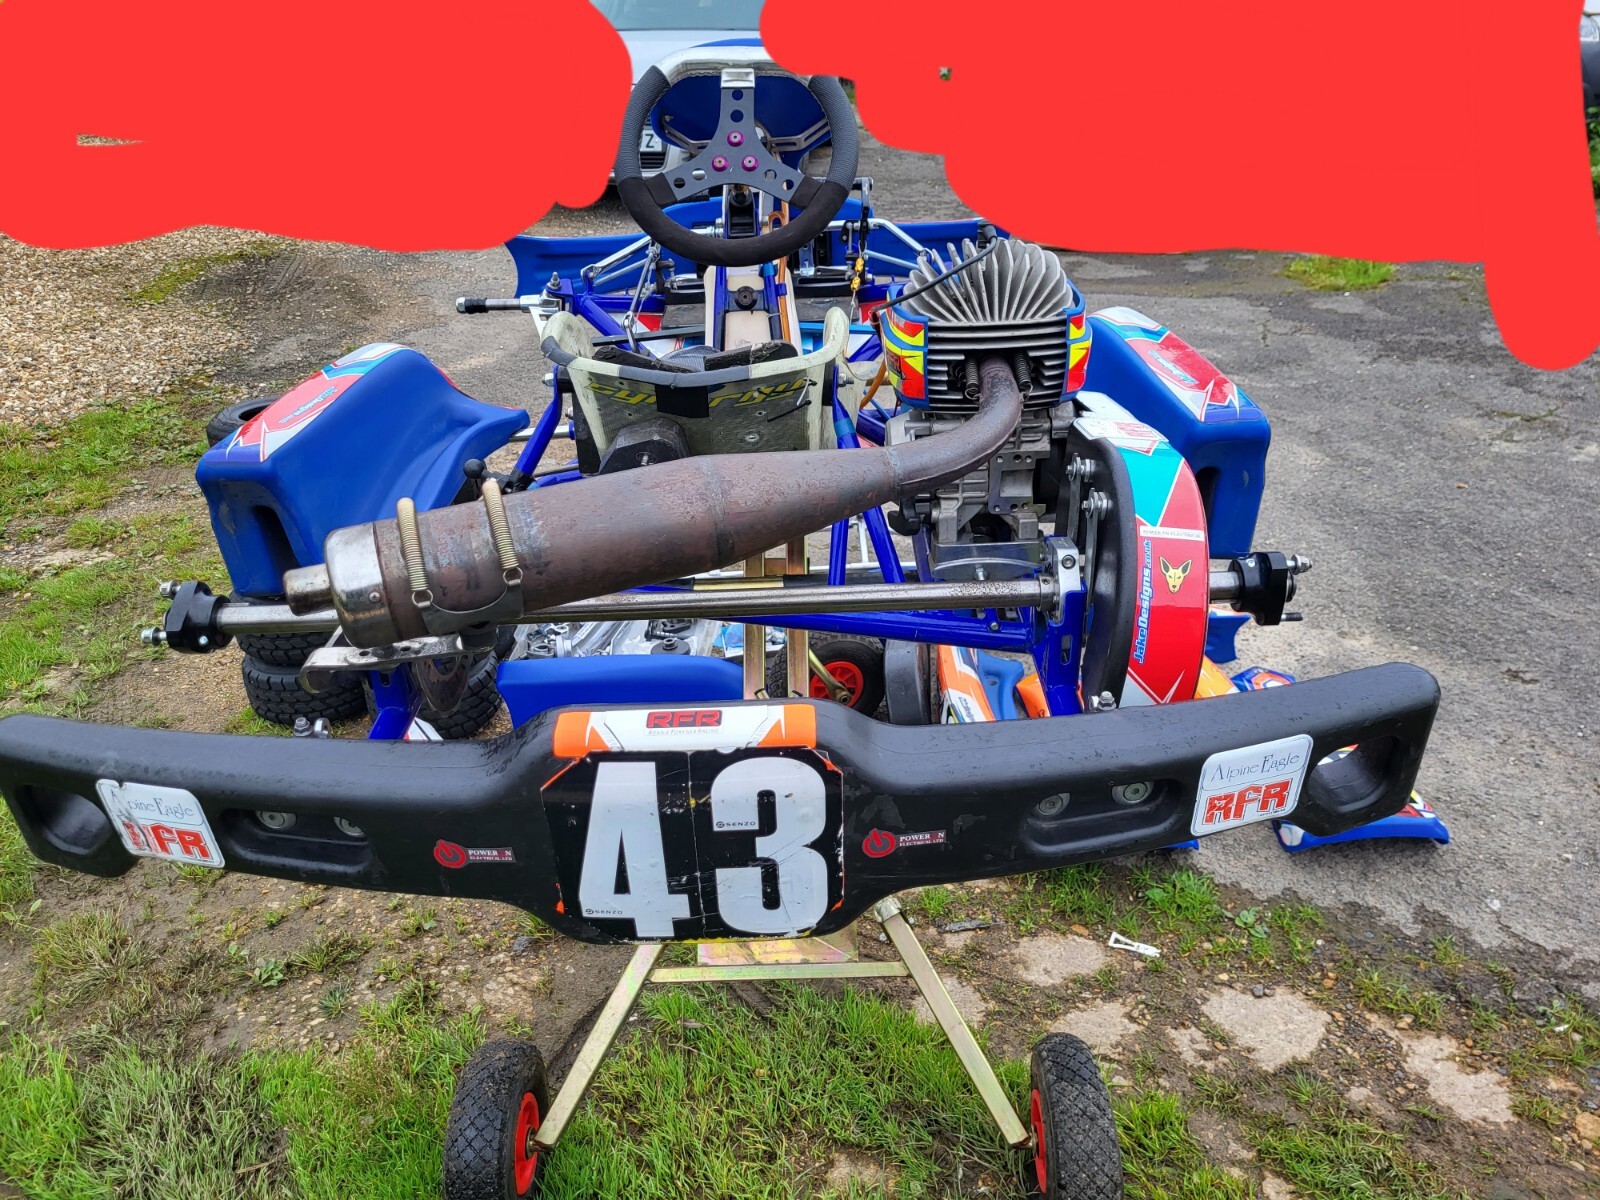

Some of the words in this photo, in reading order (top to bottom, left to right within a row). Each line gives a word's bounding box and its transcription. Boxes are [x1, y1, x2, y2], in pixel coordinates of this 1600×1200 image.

[647, 710, 722, 728] RFR
[1210, 764, 1260, 783] Alpine
[1260, 753, 1300, 775] Eagle
[152, 797, 195, 820] Eagle
[1202, 778, 1293, 825] RFR
[578, 756, 829, 938] 43
[900, 833, 931, 842] POWER
